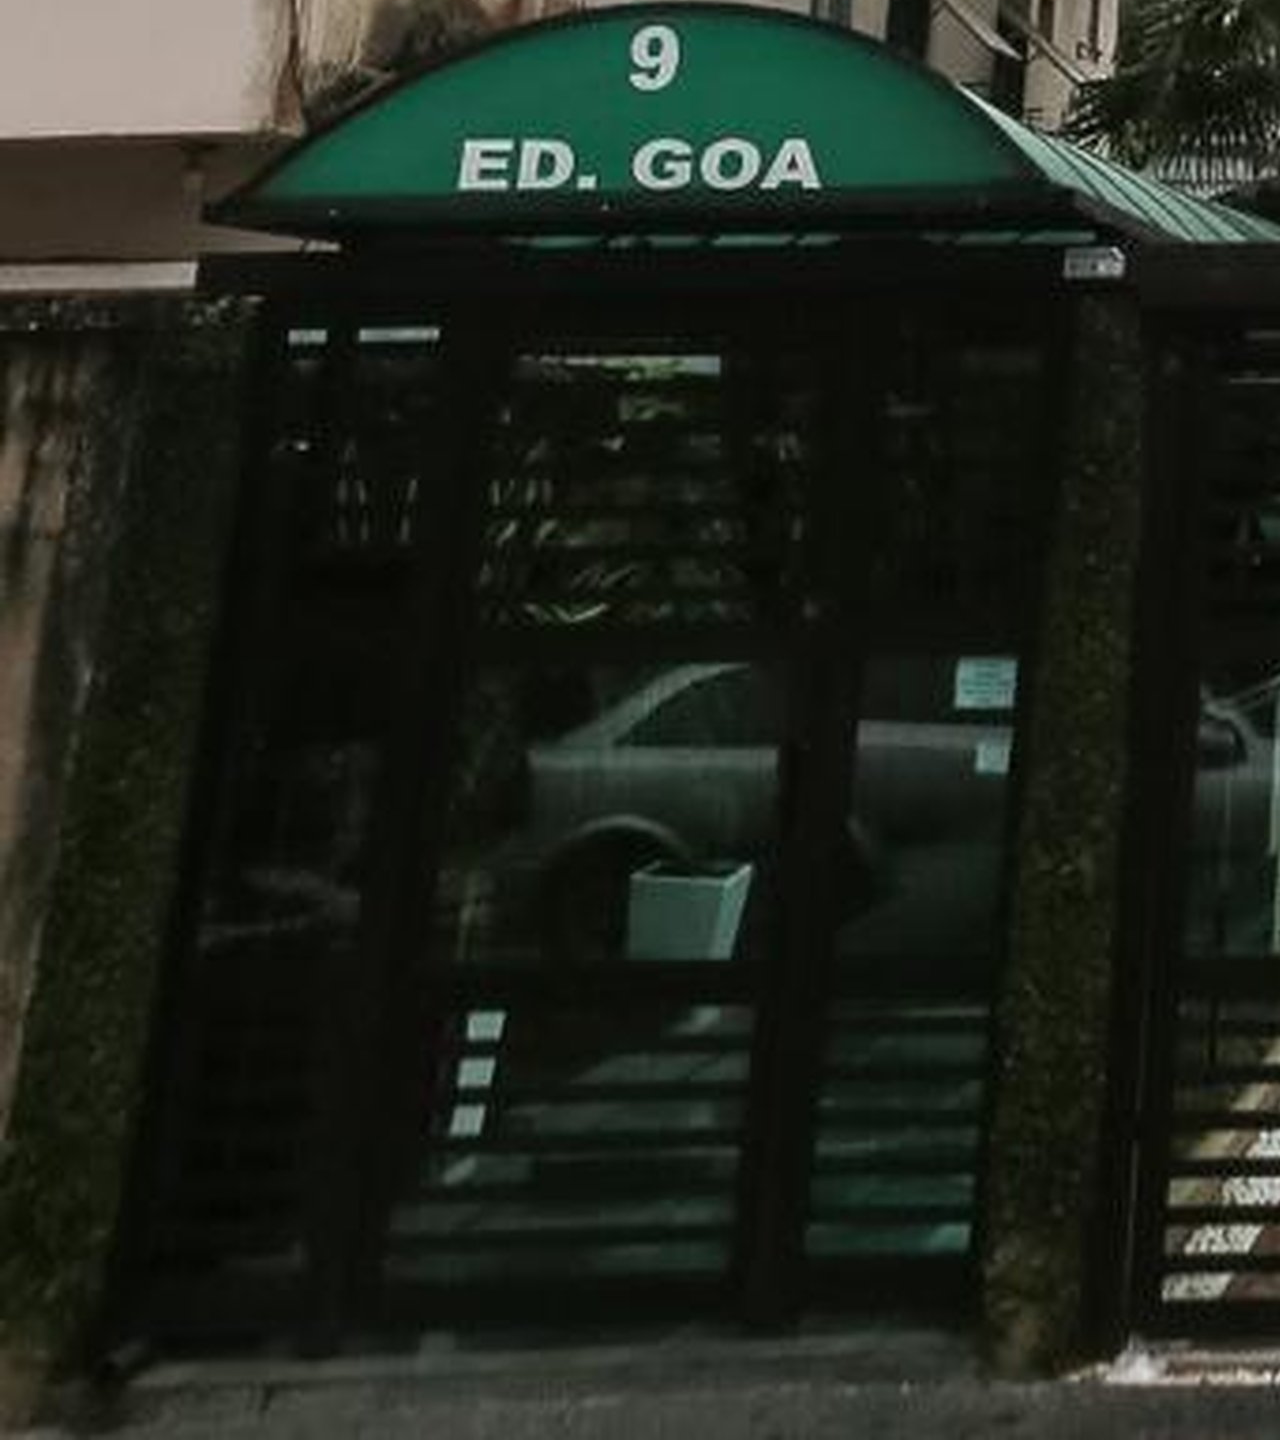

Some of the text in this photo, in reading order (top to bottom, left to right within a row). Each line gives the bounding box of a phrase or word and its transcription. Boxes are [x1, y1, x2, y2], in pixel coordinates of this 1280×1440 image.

[630, 25, 680, 91] 9
[457, 136, 823, 191] ED. GOA
